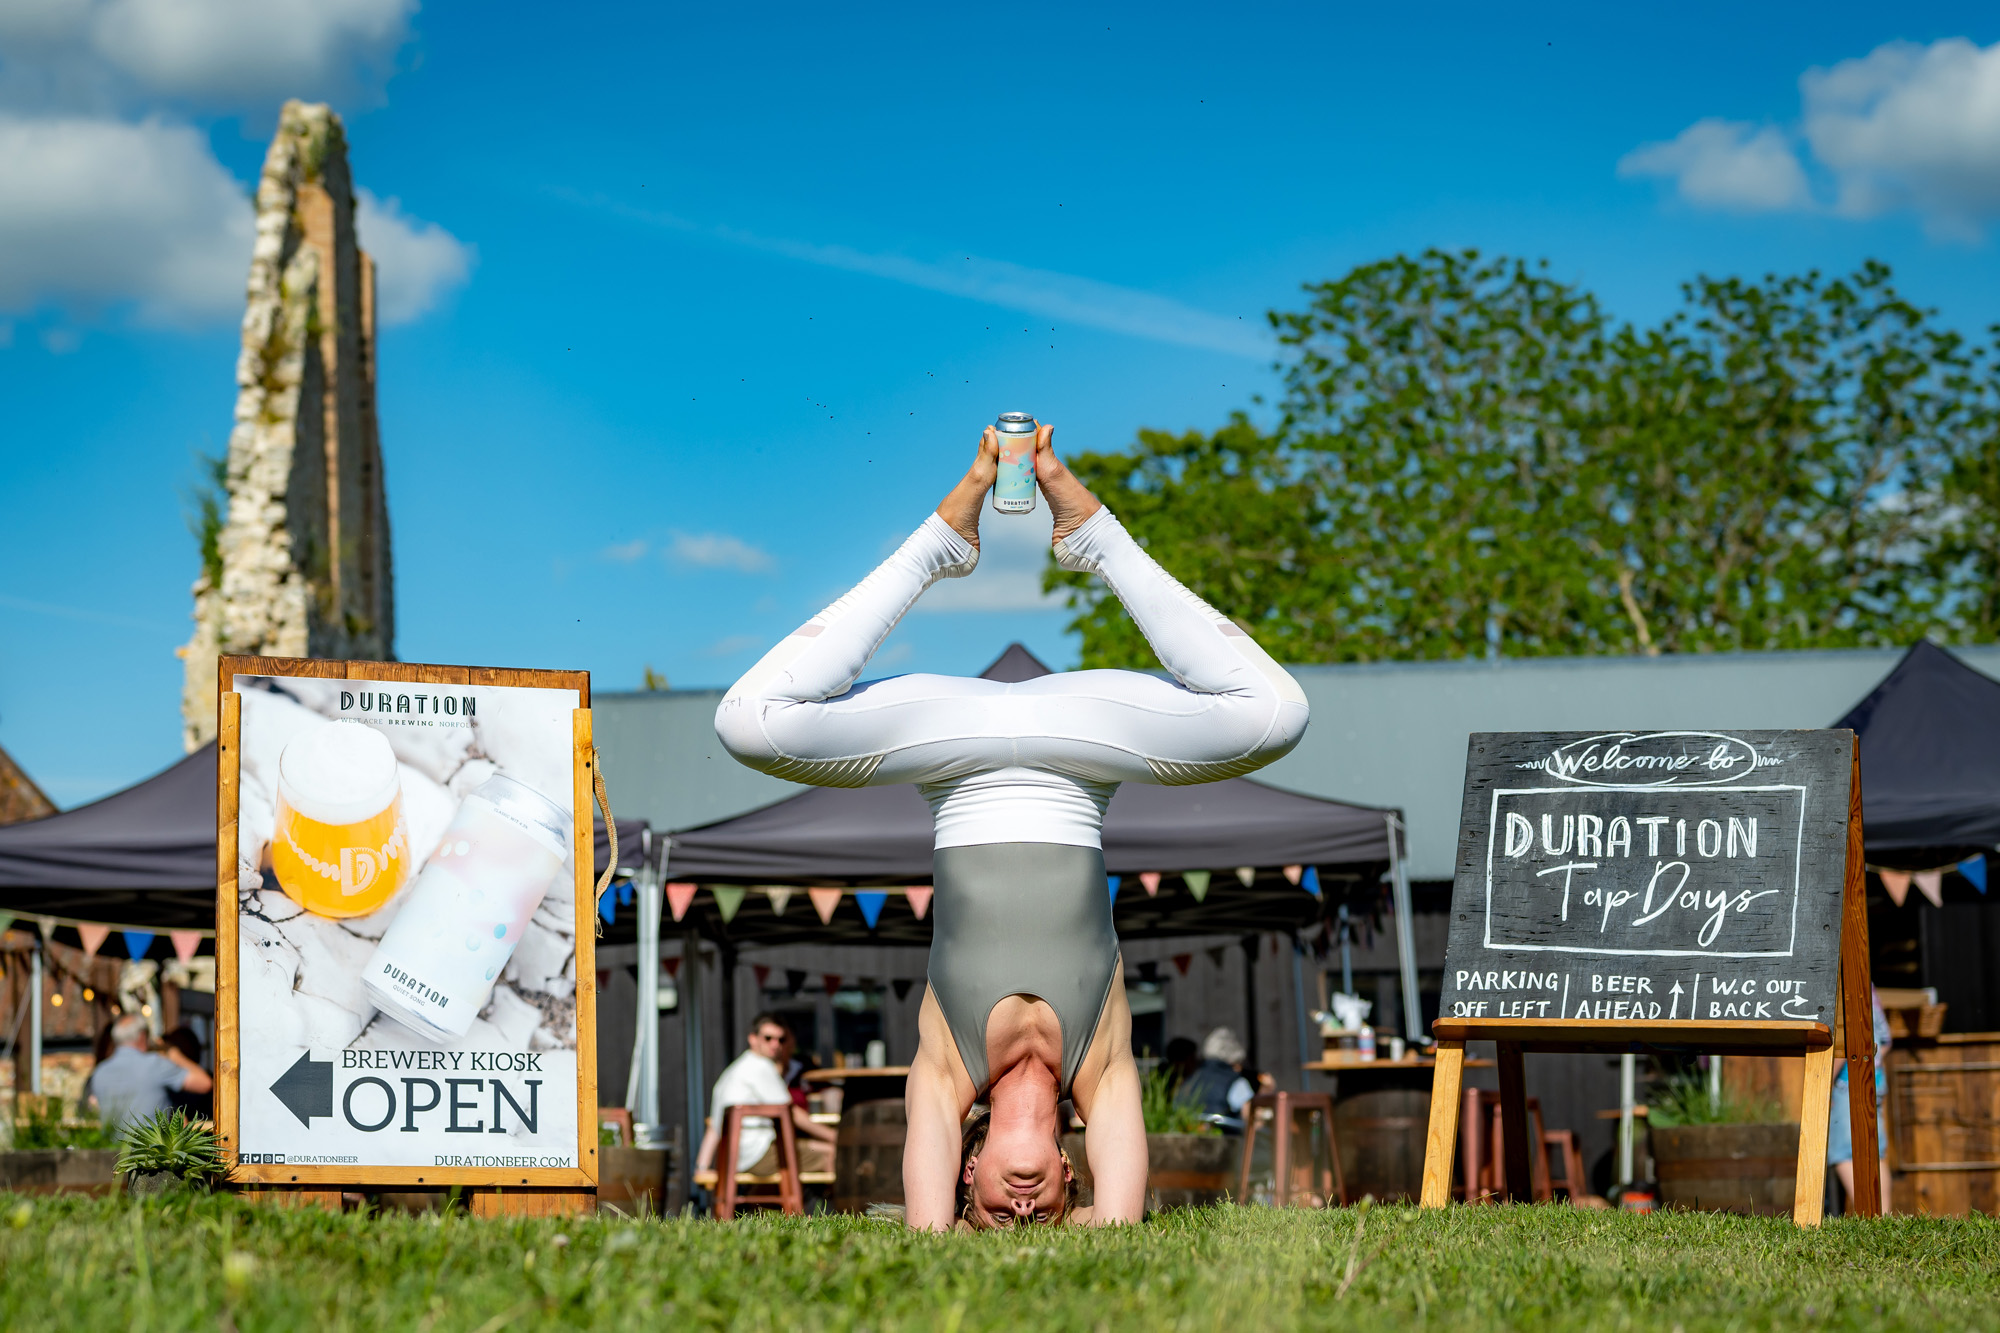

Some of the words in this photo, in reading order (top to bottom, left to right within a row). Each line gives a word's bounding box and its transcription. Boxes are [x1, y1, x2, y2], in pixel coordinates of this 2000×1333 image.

[340, 691, 476, 716] DURATION
[340, 716, 361, 724] WEST
[388, 719, 434, 727] BREWING
[439, 721, 475, 729] NORFOLK
[1552, 744, 1699, 777] Welcome
[1700, 744, 1745, 770] to
[1504, 812, 1758, 859] DURATION
[1536, 860, 1640, 933] Tap
[1632, 860, 1780, 947] Days
[383, 963, 449, 1008] DURATION
[1456, 970, 1558, 991] PARKING
[1592, 974, 1653, 993] BEER
[1712, 977, 1756, 995] W.C
[1766, 980, 1807, 994] OUT
[392, 984, 410, 997] QUIET
[409, 994, 426, 1007] SONG
[1453, 1001, 1488, 1018] OFF
[1500, 1000, 1551, 1018] LEFT
[1575, 1000, 1661, 1019] AHEAD
[1709, 1001, 1771, 1018] BACK
[342, 1050, 464, 1070] BREWERY
[470, 1052, 543, 1072] KIOSK
[342, 1076, 543, 1134] OPEN
[287, 1155, 359, 1163] @DURATIONBEER
[434, 1155, 571, 1167] DURATIONBEER.COM
